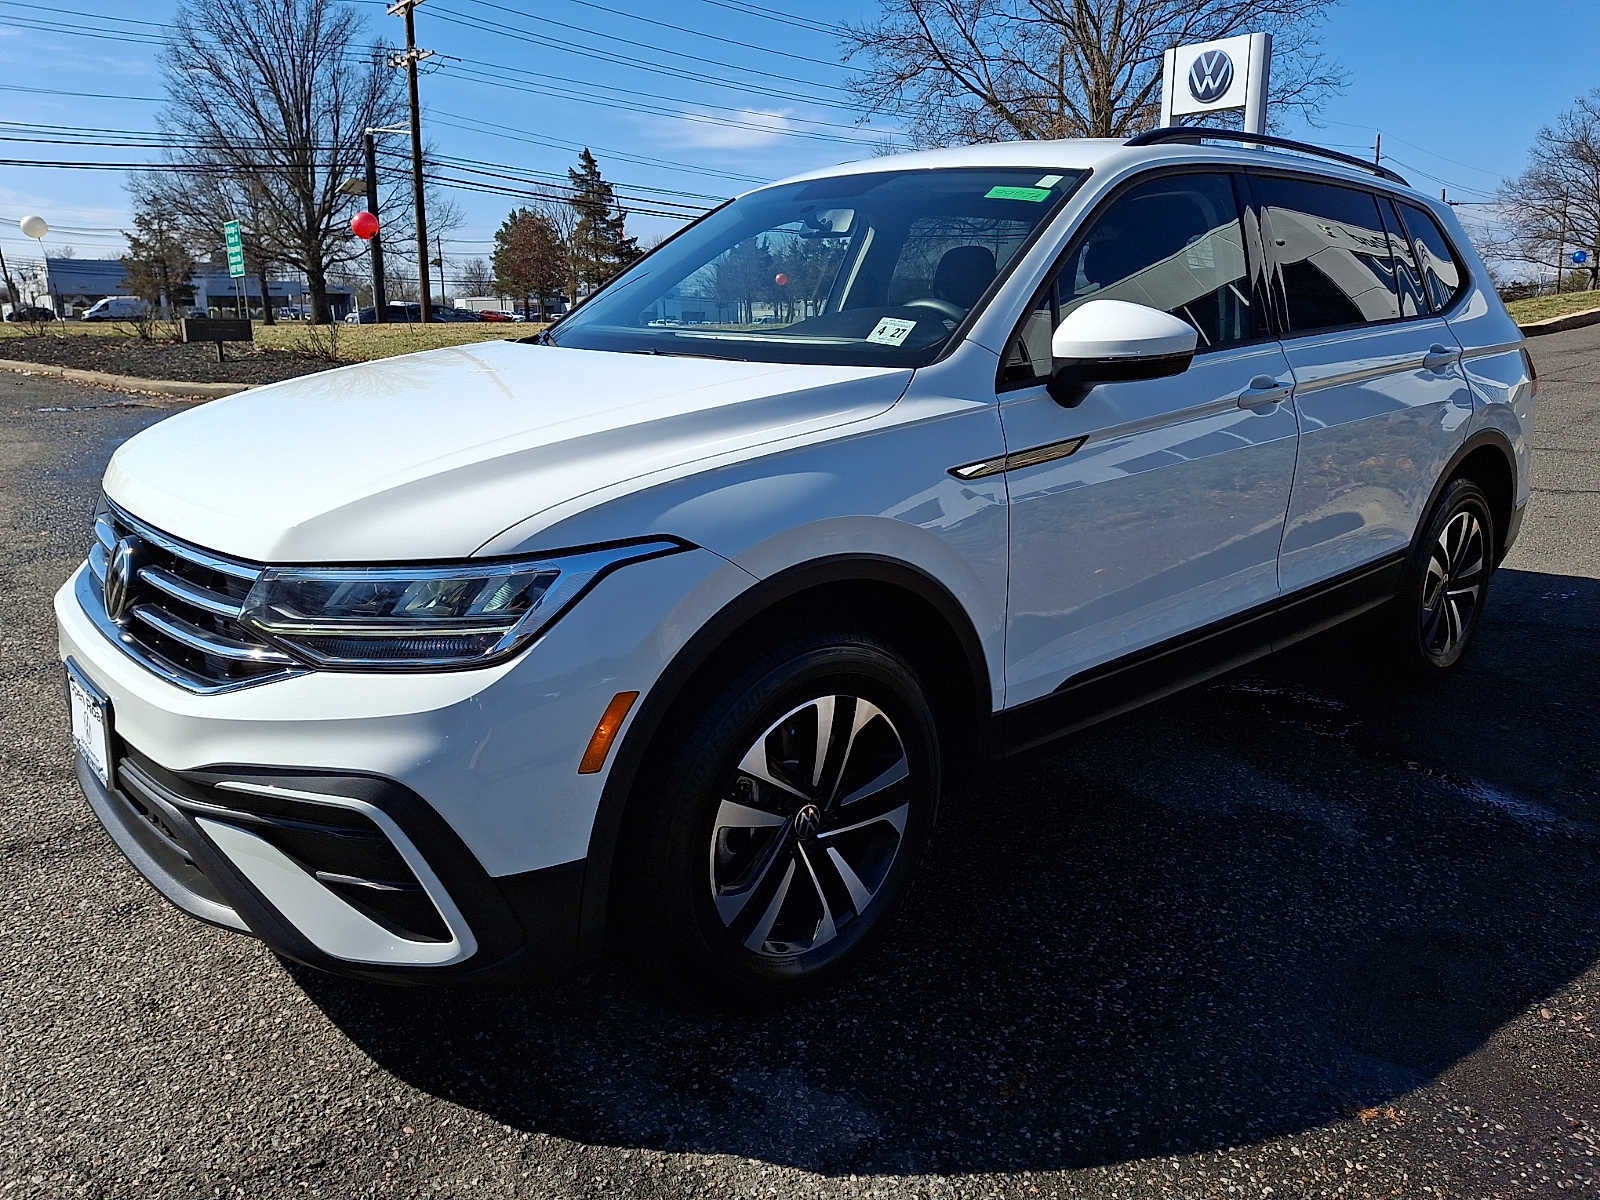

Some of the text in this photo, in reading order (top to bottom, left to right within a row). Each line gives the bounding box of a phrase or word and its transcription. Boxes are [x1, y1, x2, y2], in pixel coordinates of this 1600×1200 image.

[1190, 50, 1231, 99] VW
[878, 326, 907, 338] 4 27
